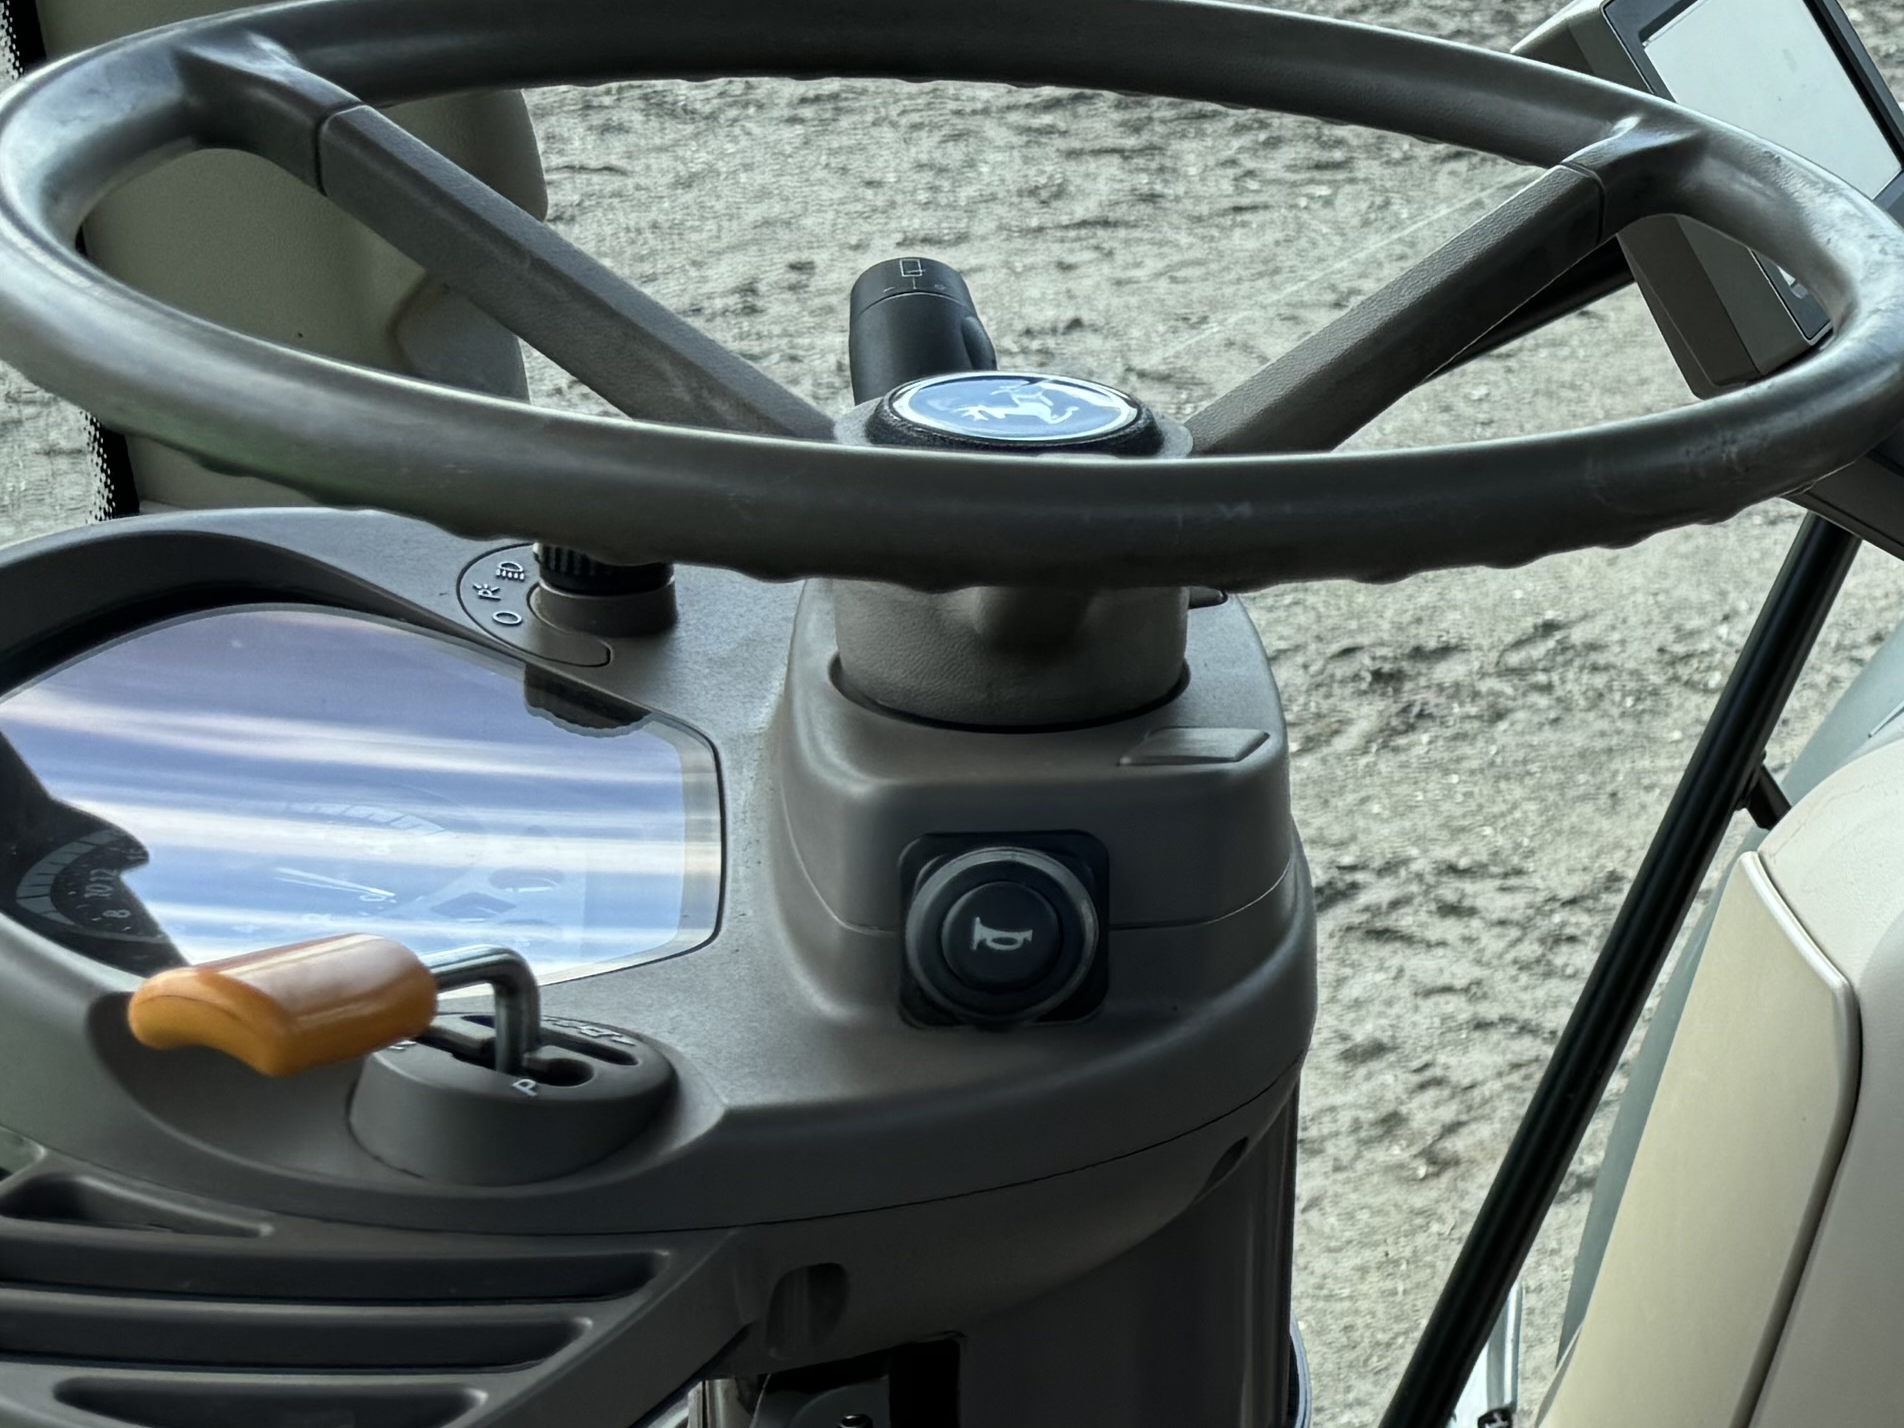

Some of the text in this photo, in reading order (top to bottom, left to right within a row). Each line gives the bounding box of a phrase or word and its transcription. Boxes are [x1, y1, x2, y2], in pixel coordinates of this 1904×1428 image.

[83, 883, 113, 898] 10
[102, 909, 131, 919] 8
[512, 1078, 538, 1097] P
